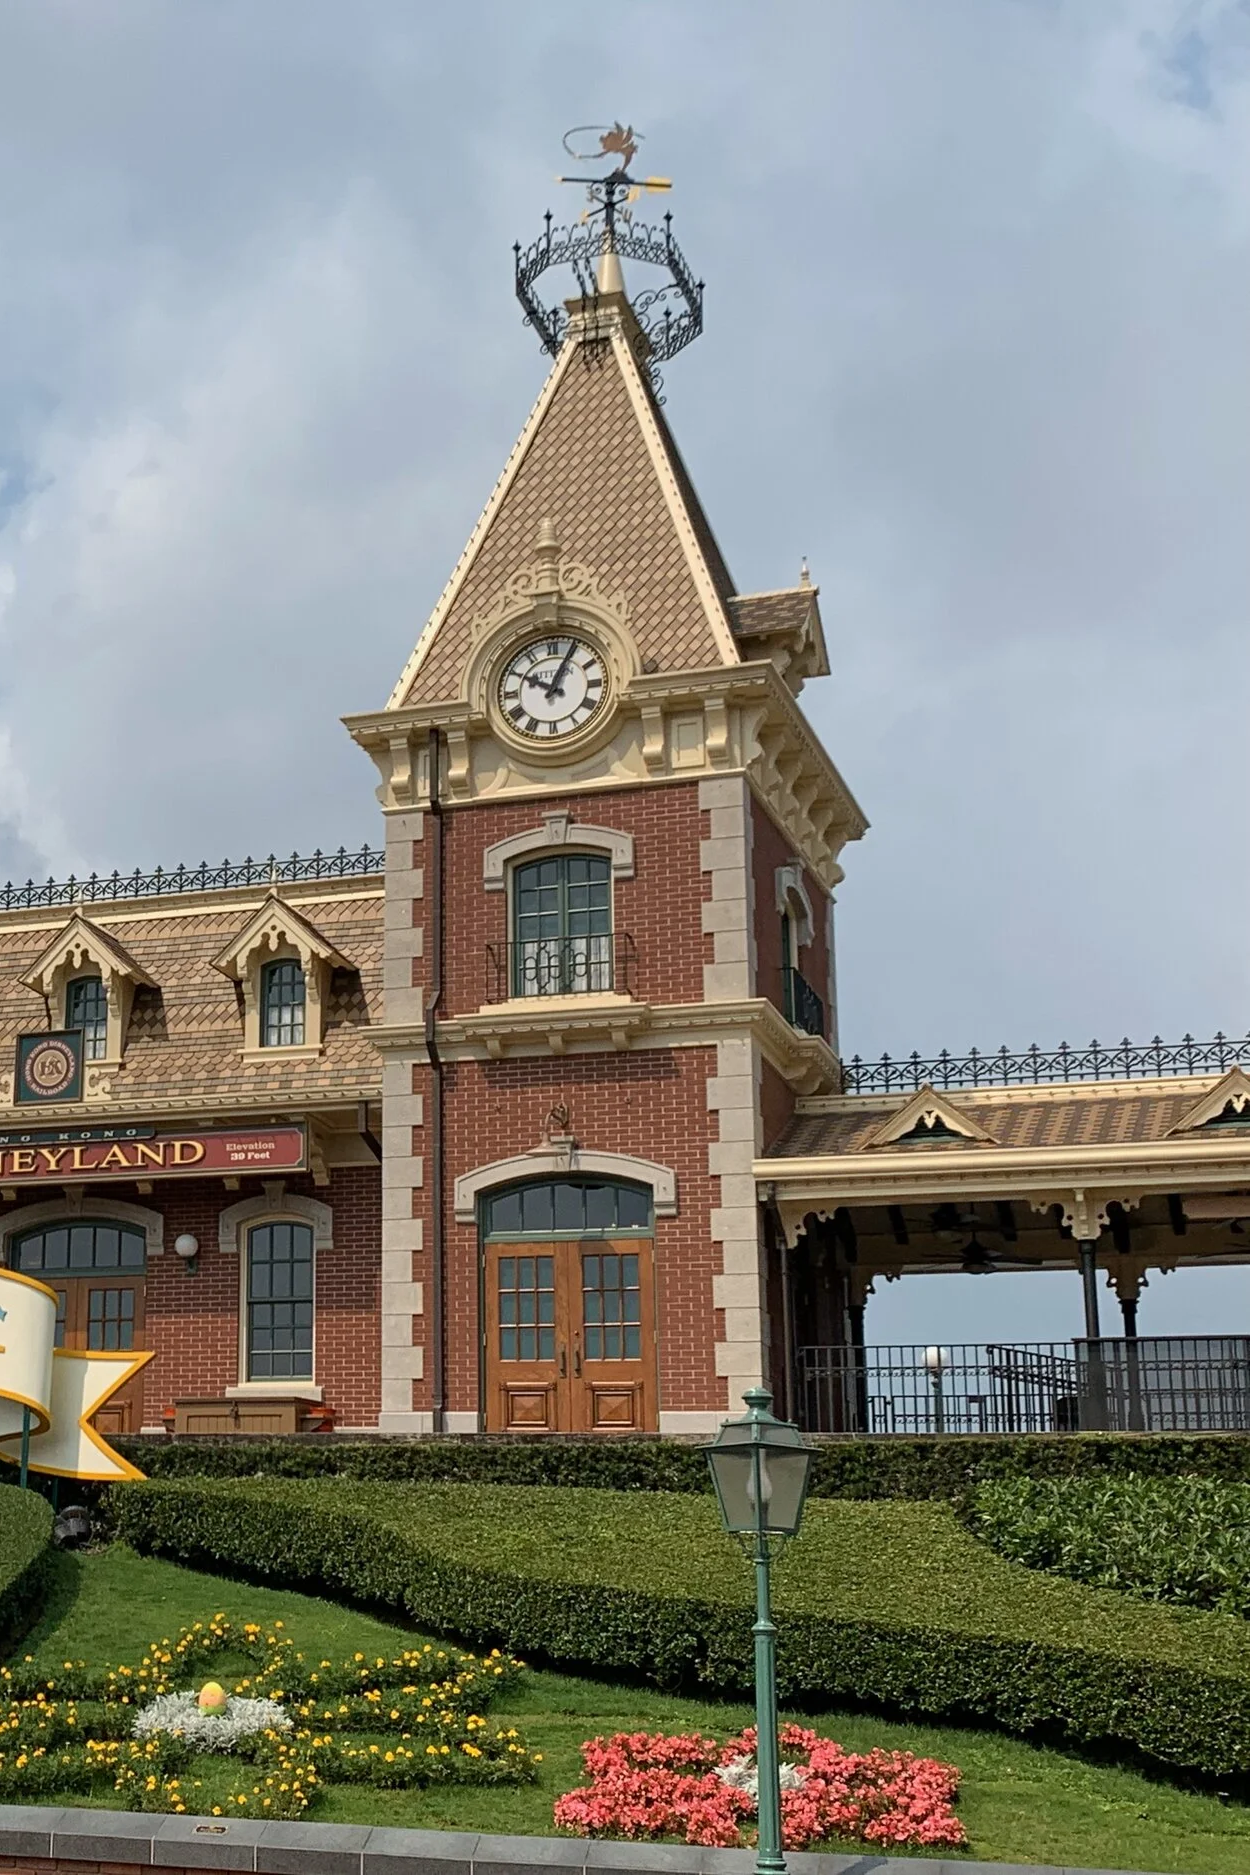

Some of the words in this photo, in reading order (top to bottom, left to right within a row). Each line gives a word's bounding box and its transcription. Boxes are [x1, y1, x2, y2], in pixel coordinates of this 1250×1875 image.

[59, 1128, 137, 1140] KONG
[225, 1141, 276, 1151] Elevation
[247, 1151, 270, 1160] Feet
